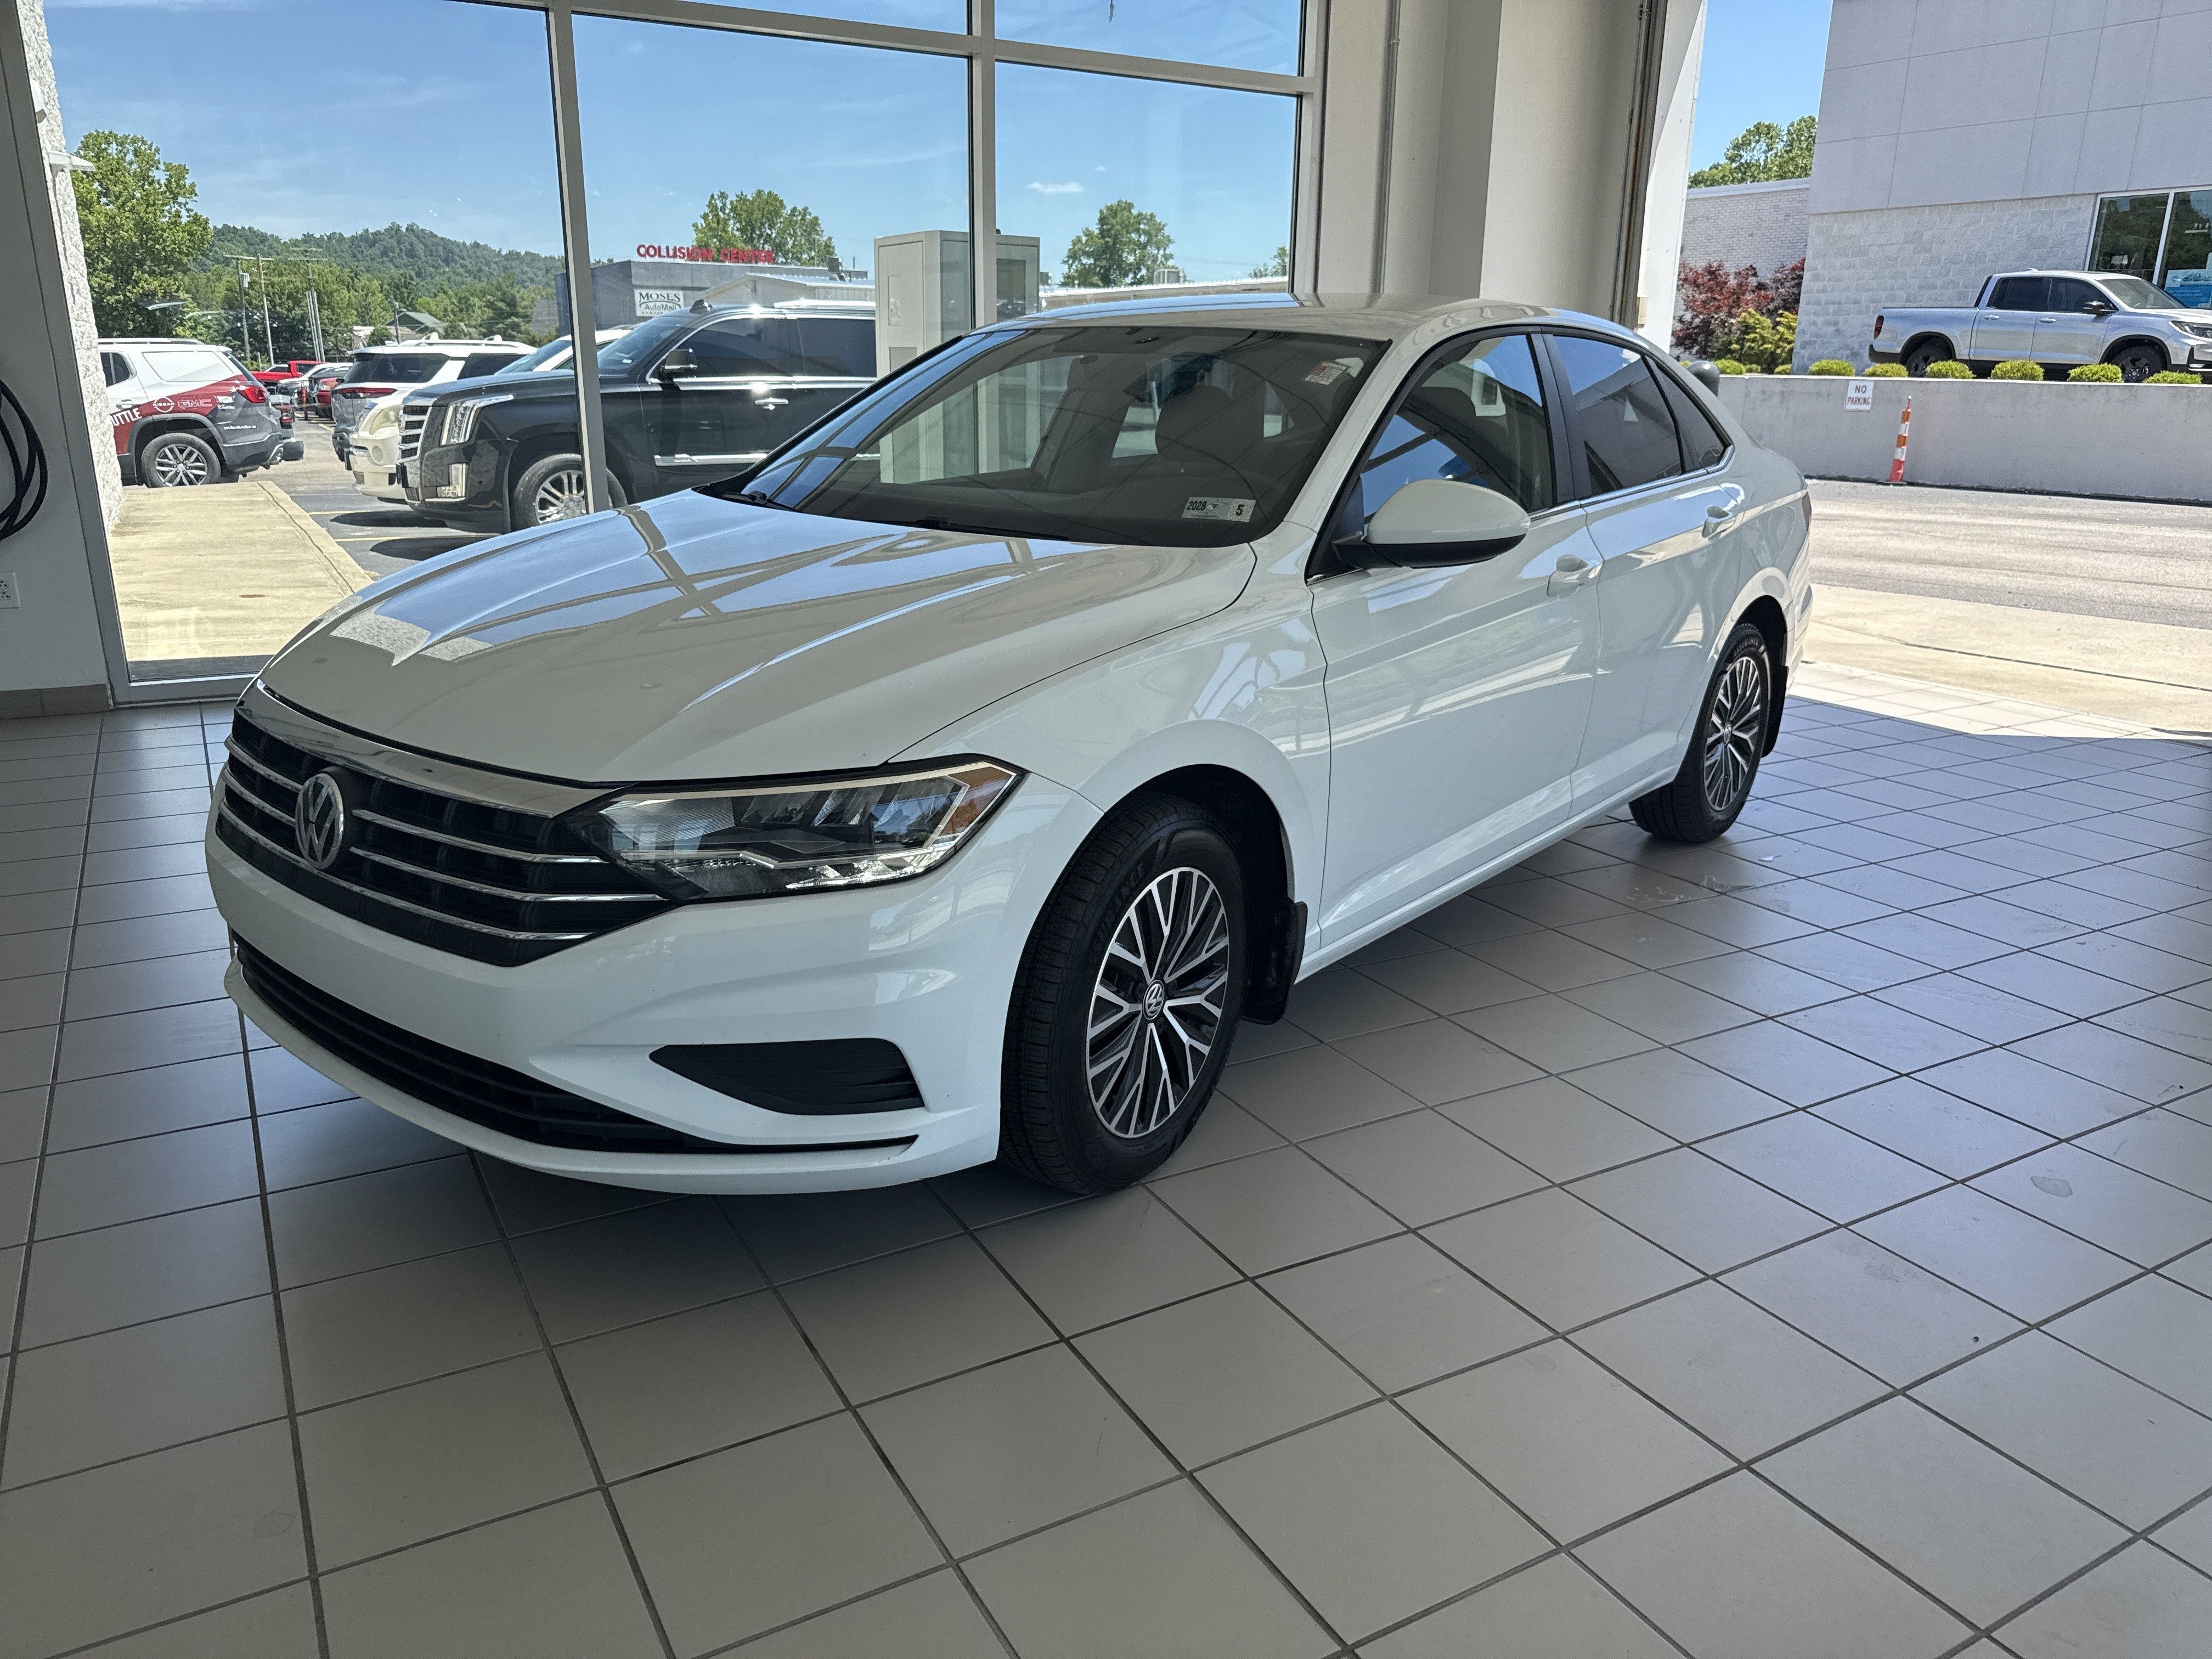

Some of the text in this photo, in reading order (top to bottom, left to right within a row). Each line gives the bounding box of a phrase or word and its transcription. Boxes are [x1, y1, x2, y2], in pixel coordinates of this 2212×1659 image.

[636, 244, 774, 264] COLLISION CENTER
[639, 292, 680, 303] MOSES
[645, 303, 677, 312] AutoMall
[1855, 385, 1867, 394] NO
[177, 399, 212, 408] GMC
[1847, 396, 1871, 406] PARKING
[110, 408, 142, 426] UTTLE
[1235, 504, 1245, 516] 5
